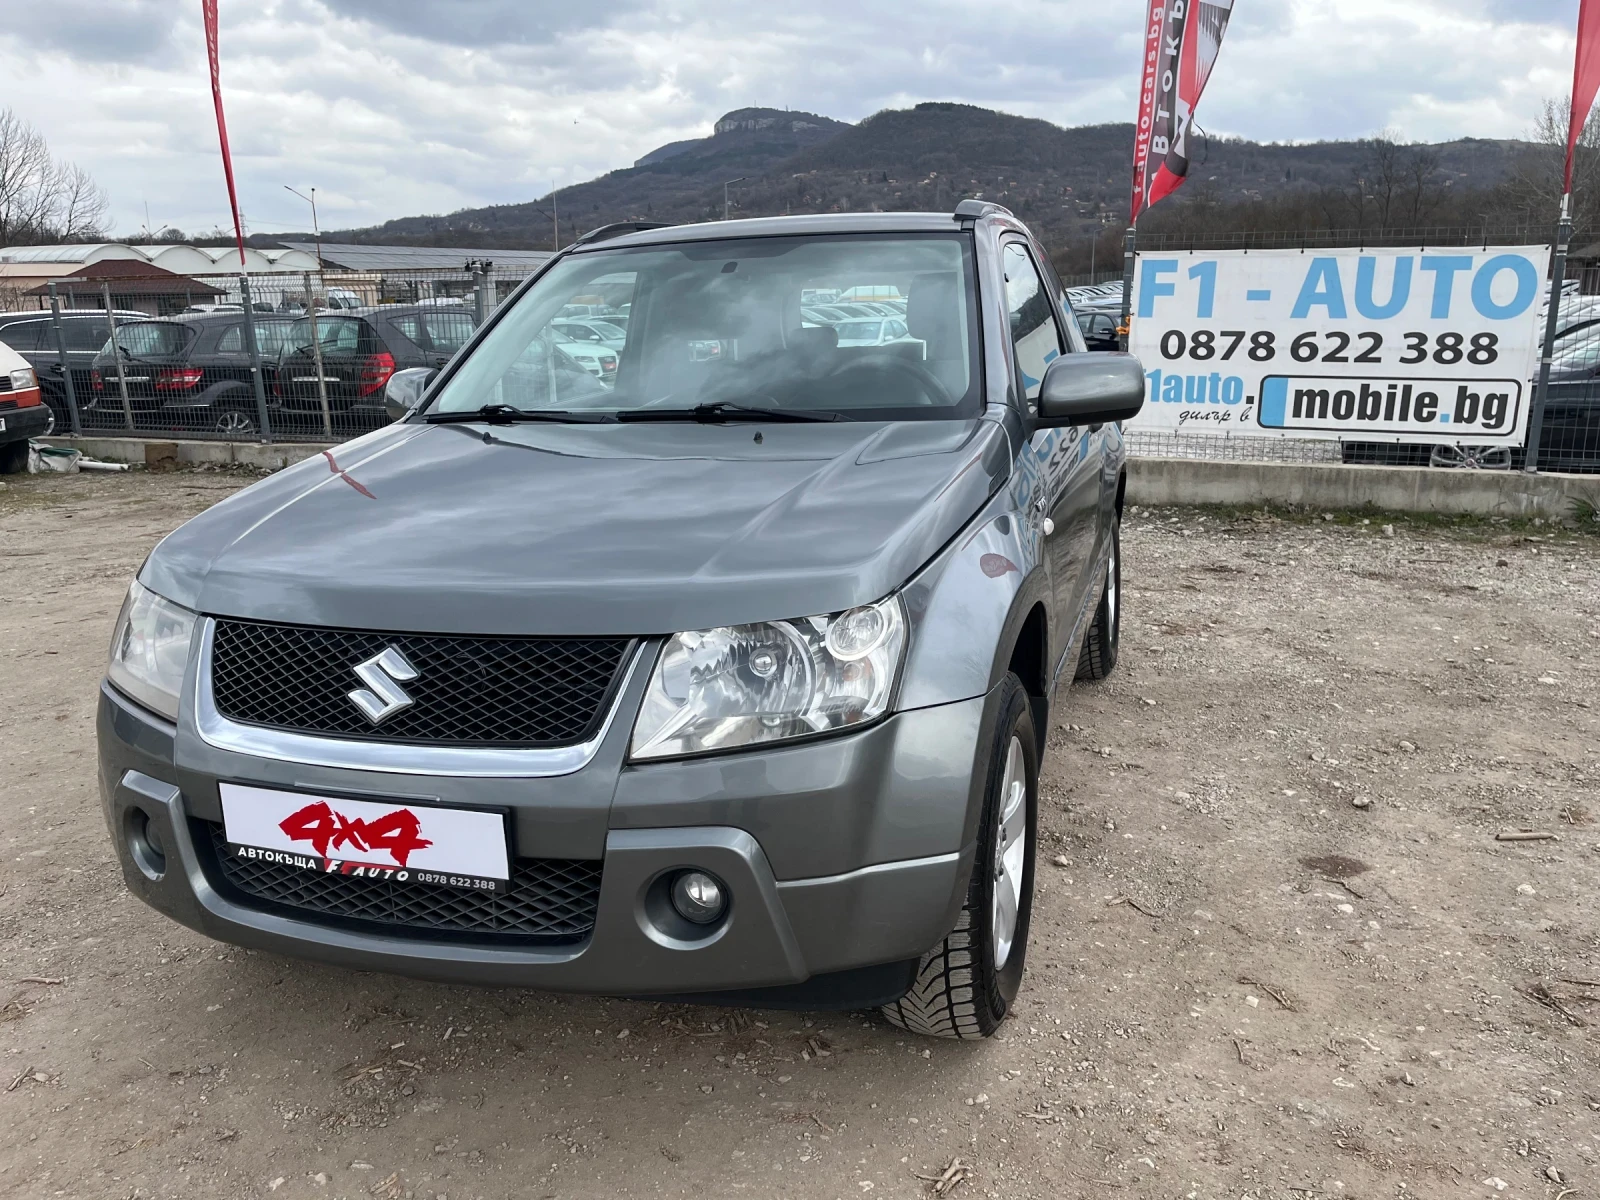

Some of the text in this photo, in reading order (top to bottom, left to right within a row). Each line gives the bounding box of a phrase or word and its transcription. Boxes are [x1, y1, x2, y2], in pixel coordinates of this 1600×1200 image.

[1138, 254, 1538, 320] F1 - AUTO
[1160, 329, 1499, 365] 0878 622 388
[1179, 409, 1232, 425] дилър
[1292, 384, 1509, 429] mobile.bg
[237, 846, 317, 870] АВТОКЪЩА
[352, 866, 410, 882] AUTO
[417, 872, 447, 885] 0878
[450, 876, 471, 888] 622
[473, 879, 496, 891] 388
